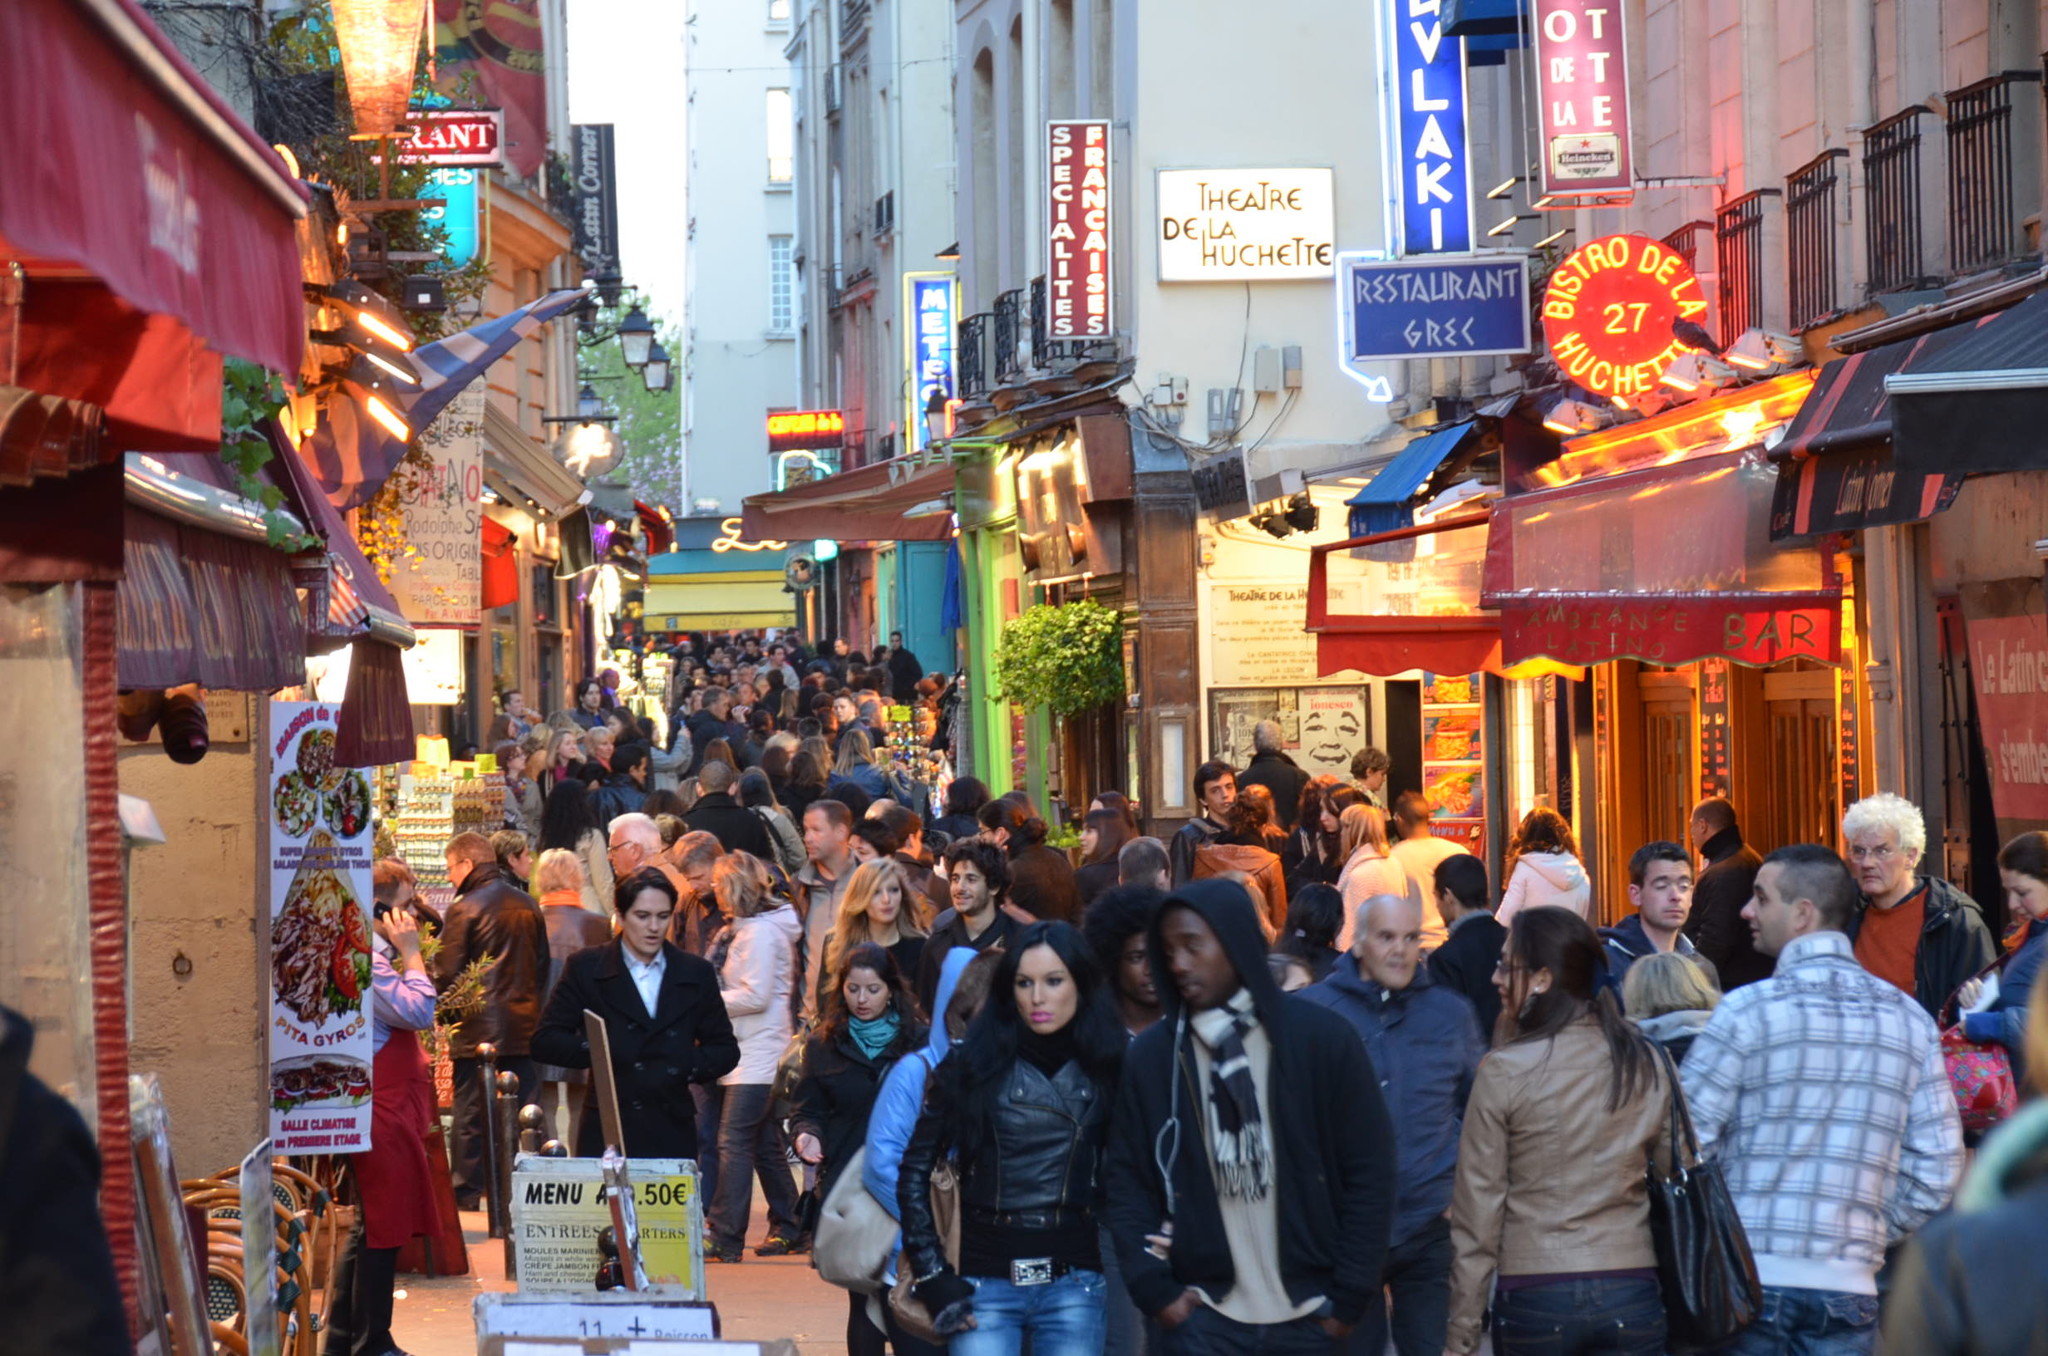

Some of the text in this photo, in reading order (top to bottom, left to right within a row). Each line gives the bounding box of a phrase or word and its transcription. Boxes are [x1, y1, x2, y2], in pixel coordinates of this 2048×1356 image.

[1551, 57, 1575, 84] DE
[1553, 101, 1577, 127] LA
[579, 125, 601, 193] Corner
[1560, 152, 1614, 165] Heineken
[1197, 182, 1303, 211] THEATRE
[584, 196, 601, 255] Latin
[1050, 126, 1077, 335] SPECIALITES
[1081, 126, 1107, 335] FRANCAISES
[1163, 217, 1237, 240] DE LA
[1202, 230, 1332, 266] HUCHETTE
[1356, 268, 1519, 304] RESTAURANT
[1544, 237, 1709, 320] BISTRO DE LA
[1403, 316, 1475, 348] GREC
[1603, 303, 1650, 335] 27
[403, 509, 463, 538] Rodolphe
[1229, 589, 1267, 601] THEATRE
[1269, 592, 1282, 600] DE
[1285, 591, 1296, 600] LA
[1525, 604, 1690, 632] AMBIANCE
[1724, 613, 1816, 650] BAR
[1547, 631, 1666, 659] LATINO
[1977, 640, 1996, 694] Le
[2000, 637, 2036, 694] Latin
[275, 705, 315, 759] MAISON
[352, 860, 371, 869] THON
[275, 1015, 366, 1047] PITA GYROS
[281, 1119, 309, 1132] SALLE
[333, 1133, 361, 1147] ETAGE
[525, 1183, 582, 1205] MENU
[631, 1183, 687, 1206] .50€
[526, 1224, 600, 1239] ENTREES
